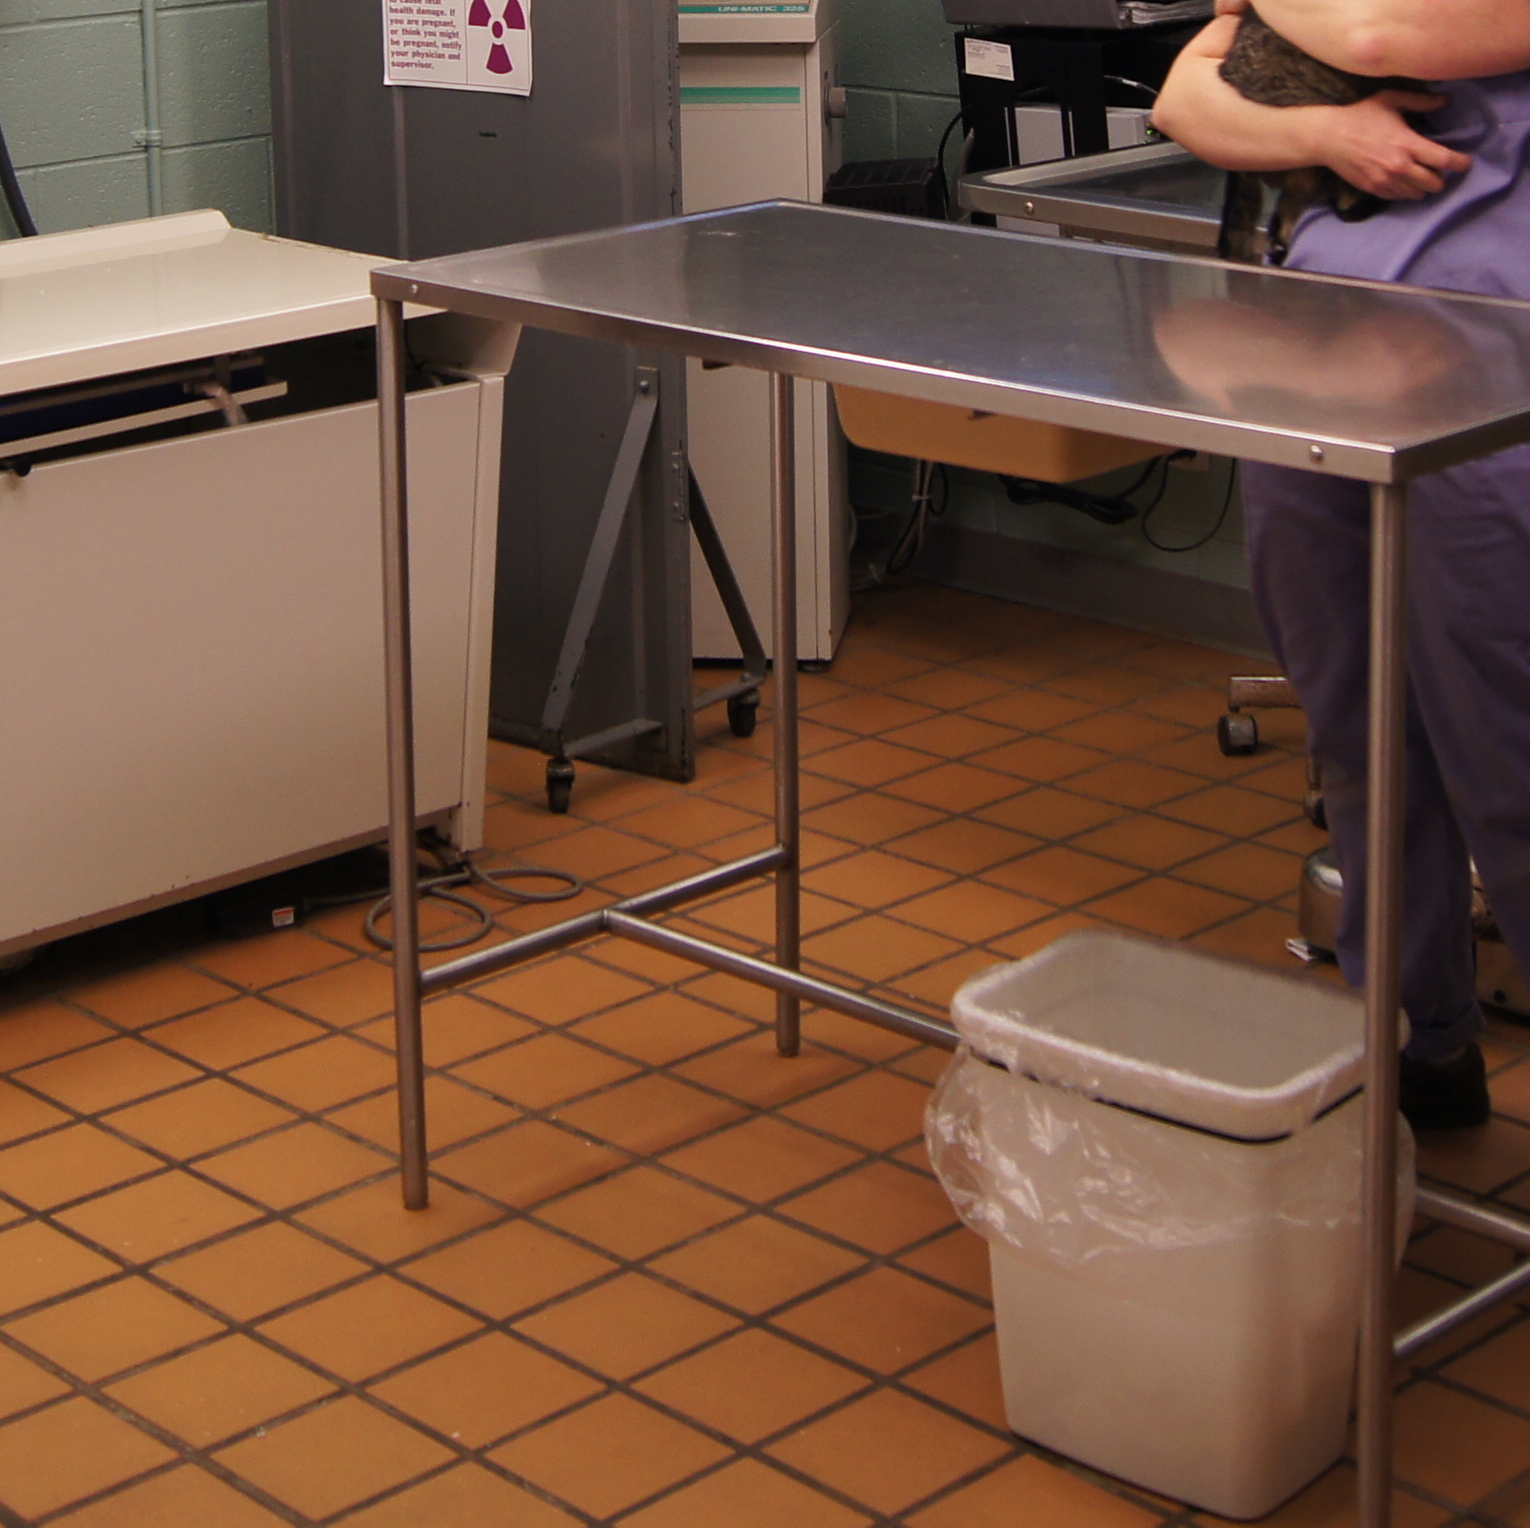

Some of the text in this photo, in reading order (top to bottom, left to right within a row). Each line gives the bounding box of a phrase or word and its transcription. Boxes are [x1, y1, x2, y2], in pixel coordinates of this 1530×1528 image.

[389, 6, 414, 14] health
[416, 7, 447, 17] damage.
[422, 20, 456, 28] pregnant,
[402, 28, 421, 36] think
[403, 40, 439, 49] pregnant,
[442, 41, 462, 50] notify
[391, 50, 461, 60] your physician and
[391, 61, 434, 69] supervisor.
